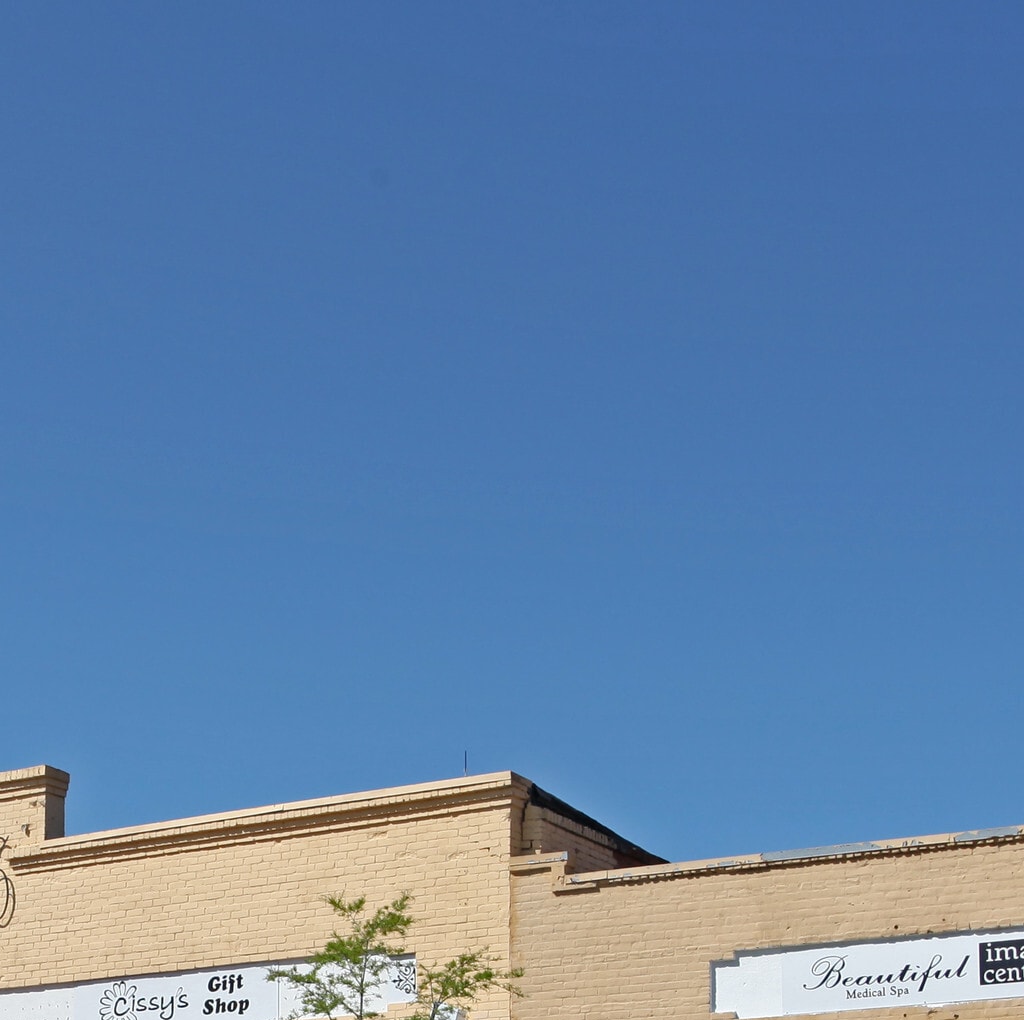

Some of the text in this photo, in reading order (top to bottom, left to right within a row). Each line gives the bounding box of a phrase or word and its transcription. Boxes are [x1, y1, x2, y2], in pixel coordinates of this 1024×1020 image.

[803, 954, 970, 992] Beautiful
[983, 965, 1024, 984] cen
[208, 973, 243, 994] Gift
[846, 985, 910, 999] Medical Spa
[114, 987, 189, 1020] Cissy's
[202, 998, 250, 1015] Shop
